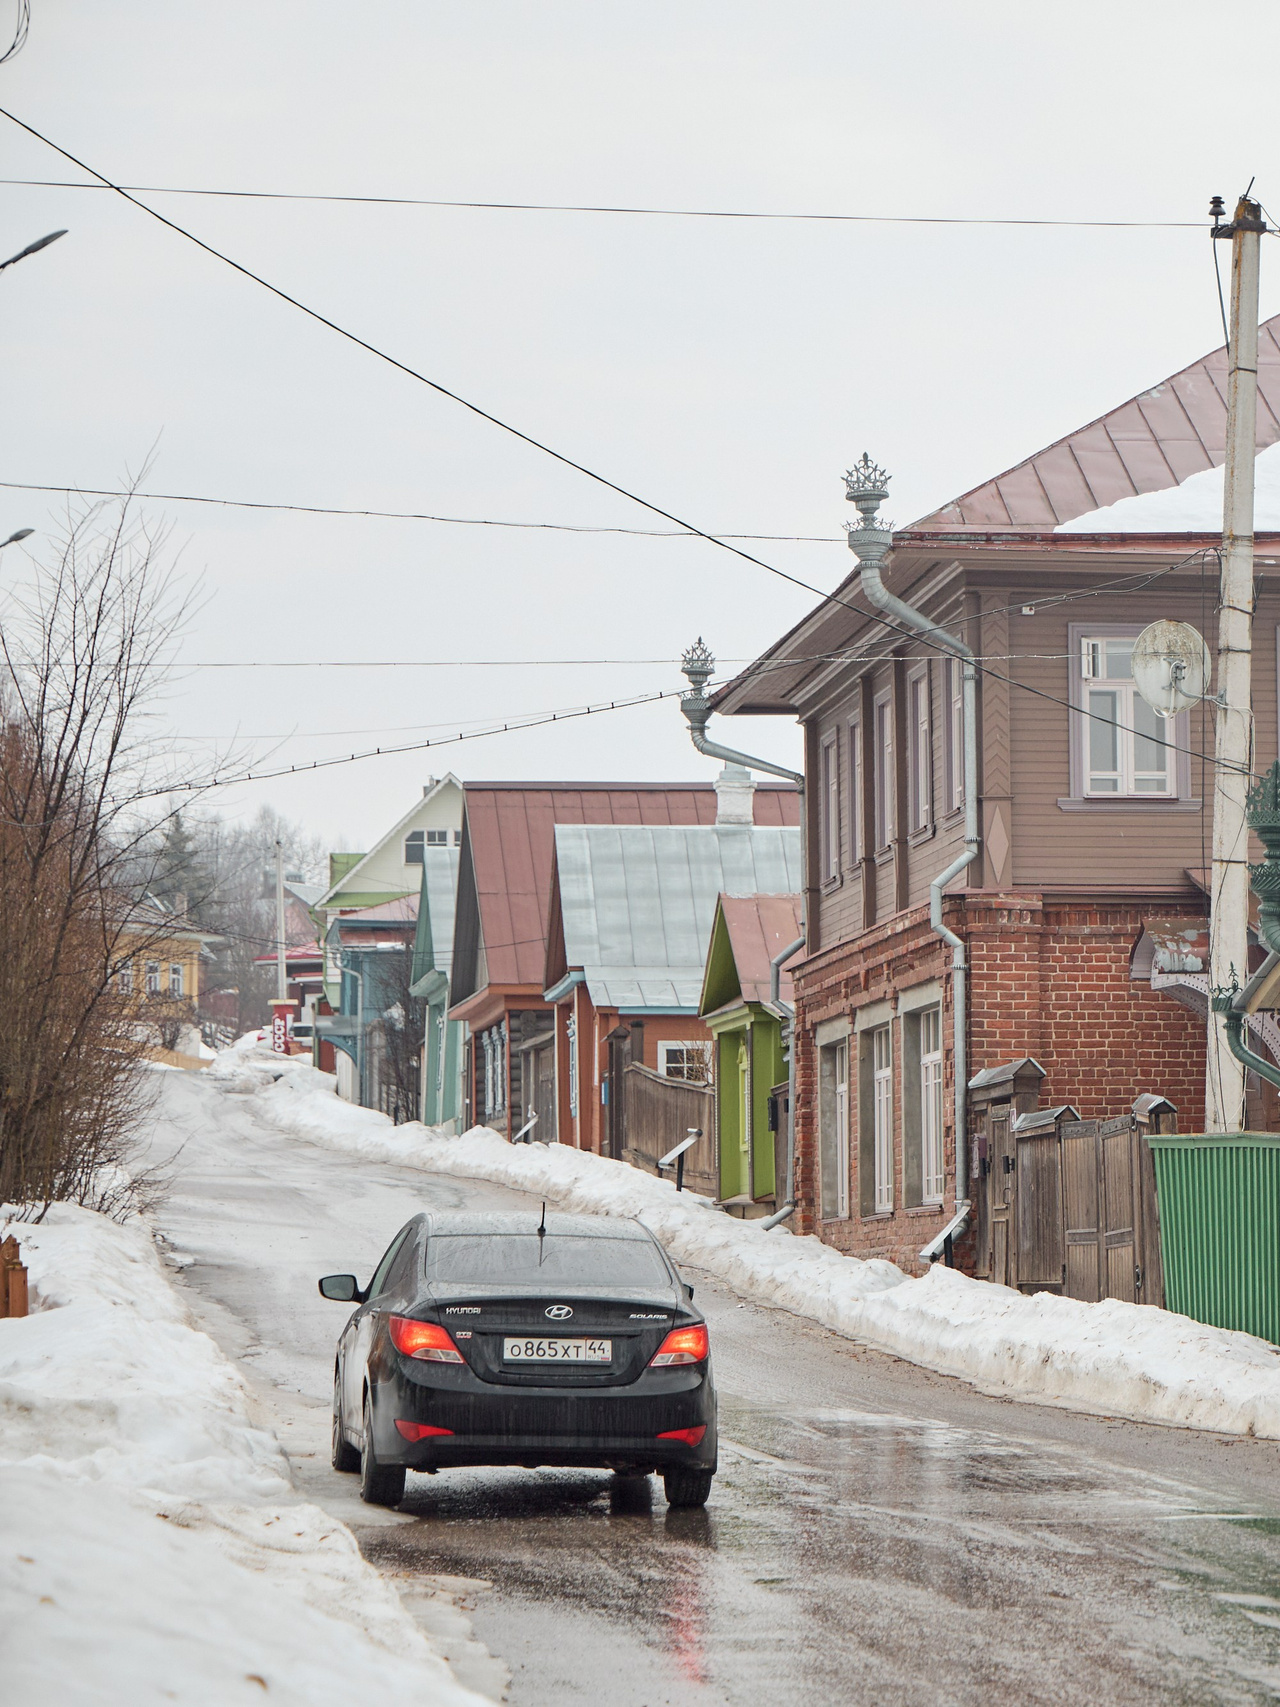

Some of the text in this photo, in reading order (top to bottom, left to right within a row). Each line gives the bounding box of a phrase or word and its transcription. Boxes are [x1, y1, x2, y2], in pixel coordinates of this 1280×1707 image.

[274, 1017, 285, 1052] СССР
[445, 1307, 482, 1315] HYUNDAI
[588, 1341, 605, 1354] 44
